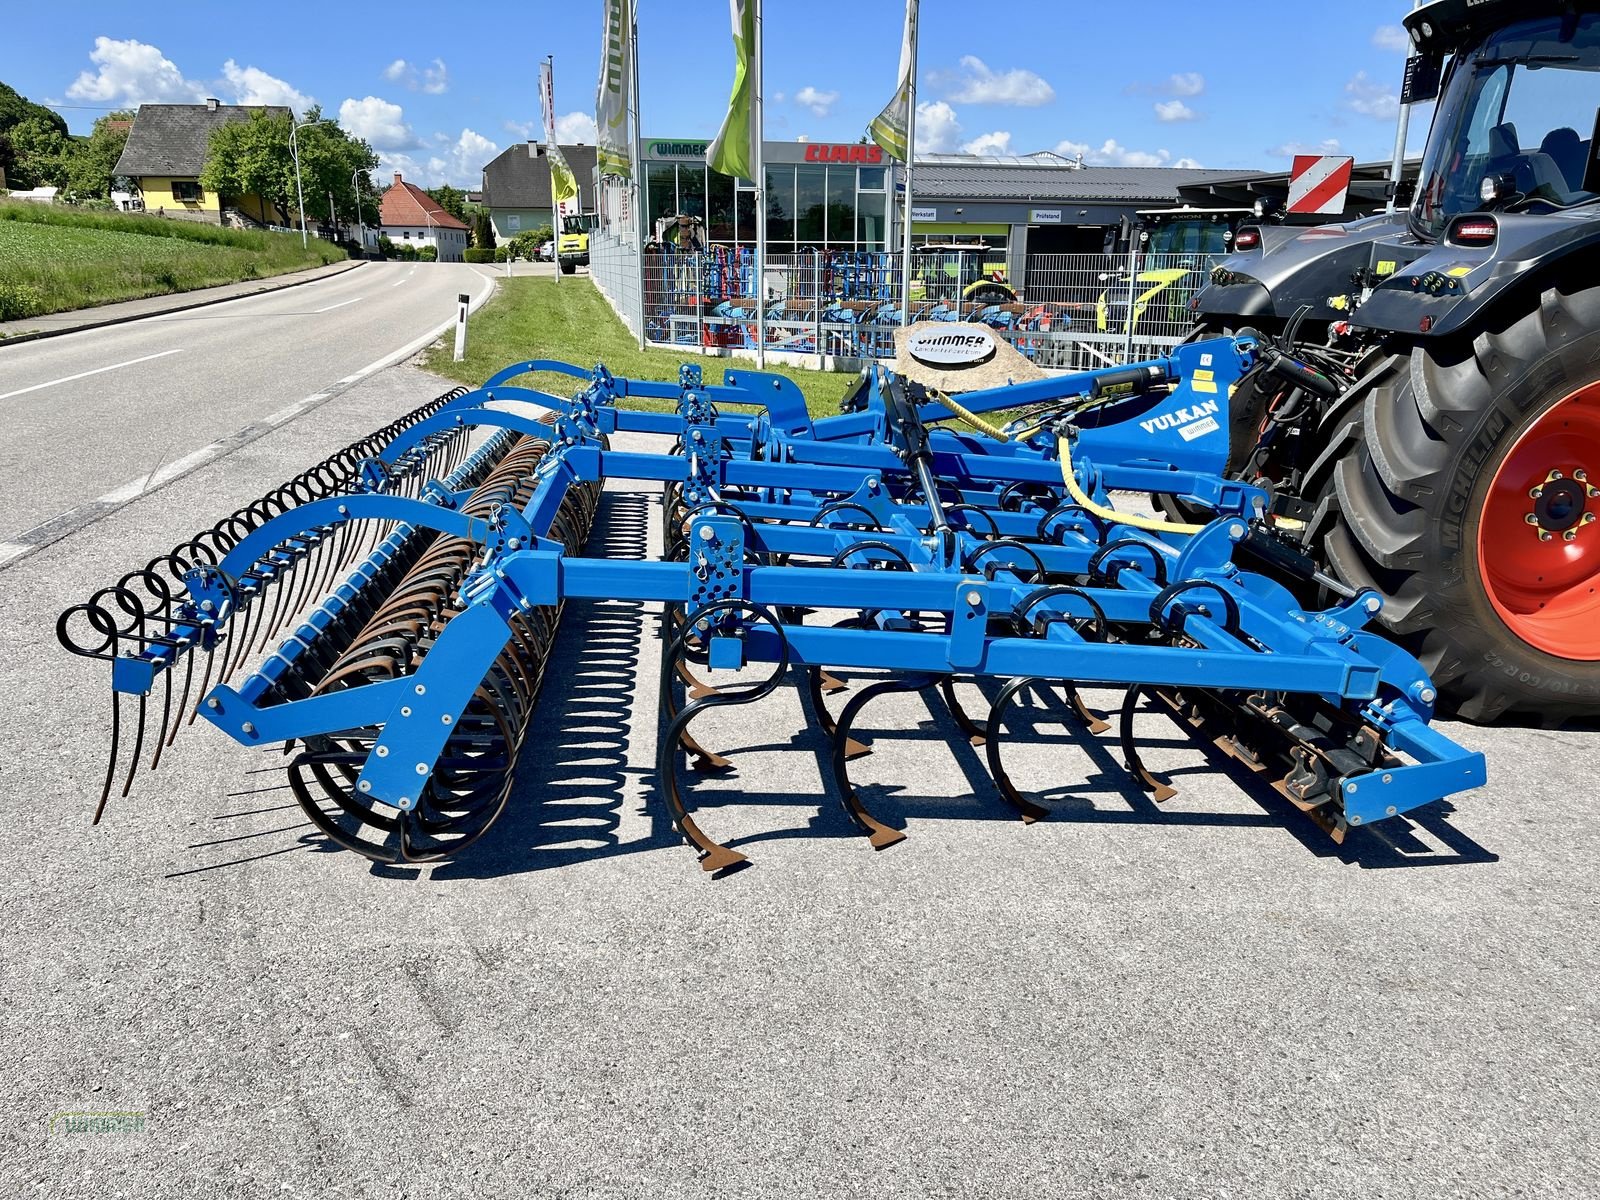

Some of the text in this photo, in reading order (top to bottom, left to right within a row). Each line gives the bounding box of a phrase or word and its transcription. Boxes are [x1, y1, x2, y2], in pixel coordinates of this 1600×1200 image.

[656, 143, 707, 156] WIMMER
[805, 144, 883, 163] CLAAS
[1139, 399, 1219, 434] VULKAN
[1186, 419, 1216, 435] WIMMER
[1440, 408, 1505, 549] MICHELIN
